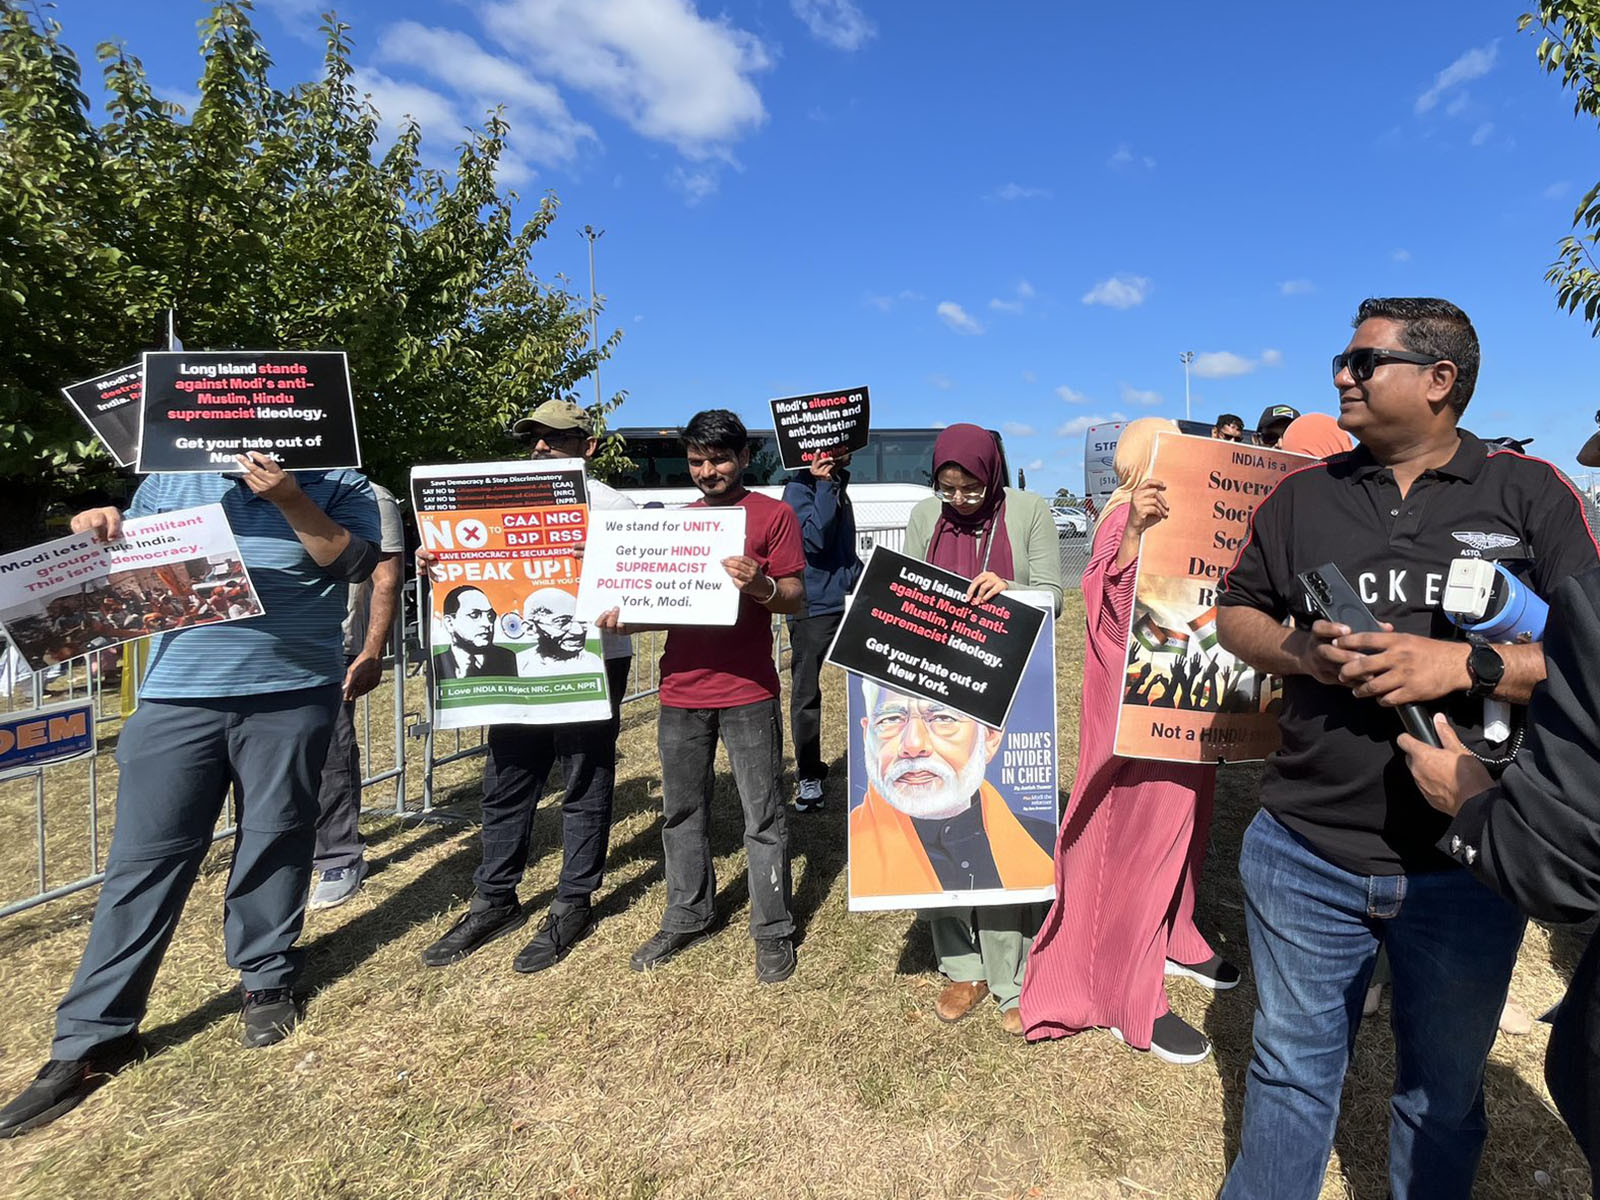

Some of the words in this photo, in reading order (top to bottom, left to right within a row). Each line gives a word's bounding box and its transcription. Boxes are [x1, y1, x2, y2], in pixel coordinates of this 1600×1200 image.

[181, 363, 216, 377] Long
[219, 363, 256, 374] Island
[259, 364, 307, 374] stands
[97, 374, 137, 390] Modi's
[175, 379, 228, 391] against
[230, 378, 274, 389] Modi's
[278, 378, 314, 389] anti-
[97, 398, 130, 411] India.
[198, 393, 250, 405] Muslim,
[253, 393, 294, 403] Hindu
[776, 400, 808, 413] Modi's
[809, 396, 847, 408] silence
[849, 393, 862, 402] on
[168, 408, 255, 421] supremacist
[257, 407, 327, 421] ideology.
[781, 409, 840, 426] anti-Muslim
[842, 405, 861, 417] and
[789, 420, 856, 438] anti-Christian
[176, 438, 204, 449] Get
[206, 439, 240, 451] your
[243, 437, 273, 448] hate
[276, 437, 302, 447] out
[305, 435, 322, 446] of
[798, 437, 839, 449] violence
[841, 432, 850, 441] is
[1232, 451, 1264, 468] INDIA
[1268, 457, 1277, 470] is
[1280, 463, 1286, 471] a
[552, 481, 573, 489] (CAA)
[554, 489, 575, 497] (NRC)
[504, 514, 540, 527] CAA
[546, 512, 582, 524] NRC
[606, 521, 623, 531] We
[626, 521, 659, 531] stand
[662, 521, 680, 531] for
[683, 521, 724, 531] UNITY.
[488, 526, 501, 534] TO
[507, 533, 539, 545] BJP
[550, 530, 582, 542] RSS
[0, 552, 50, 574] Modi
[53, 542, 89, 558] lets
[140, 516, 204, 535] militant
[616, 546, 636, 556] Get
[639, 548, 668, 558] your
[671, 546, 710, 556] HINDU
[36, 550, 100, 577] groups
[137, 536, 181, 549] India.
[461, 551, 510, 559] DEMOCRACY
[520, 548, 574, 557] SECULARISM
[25, 575, 64, 593] This
[111, 543, 204, 565] democracy.
[430, 562, 514, 582] SPEAK
[616, 562, 707, 573] SUPREMACIST
[597, 578, 652, 589] POLITICS
[655, 580, 676, 590] out
[679, 579, 692, 590] of
[695, 580, 722, 590] New
[899, 567, 932, 591] Long
[932, 579, 969, 603] Island
[622, 596, 654, 608] York,
[657, 596, 692, 607] Modi.
[889, 581, 935, 607] against
[937, 599, 978, 623] Modi's
[979, 616, 1009, 635] anti-
[901, 600, 950, 630] Muslim,
[951, 620, 987, 644] Hindu
[871, 606, 949, 645] supremacist
[948, 634, 1003, 668] ideology.
[865, 637, 890, 656] Get
[890, 647, 921, 667] your
[920, 656, 949, 678] hate
[949, 671, 972, 688] out
[974, 681, 988, 694] of
[887, 662, 915, 682] New
[918, 674, 950, 696] York.
[448, 688, 471, 696] Love
[473, 685, 497, 693] INDIA
[1151, 722, 1180, 739] Not
[1186, 729, 1195, 741] a
[1008, 732, 1051, 749] INDIA'S
[1004, 750, 1052, 767] DIVIDER
[1002, 768, 1014, 784] IN
[1018, 767, 1052, 784] CHIEF
